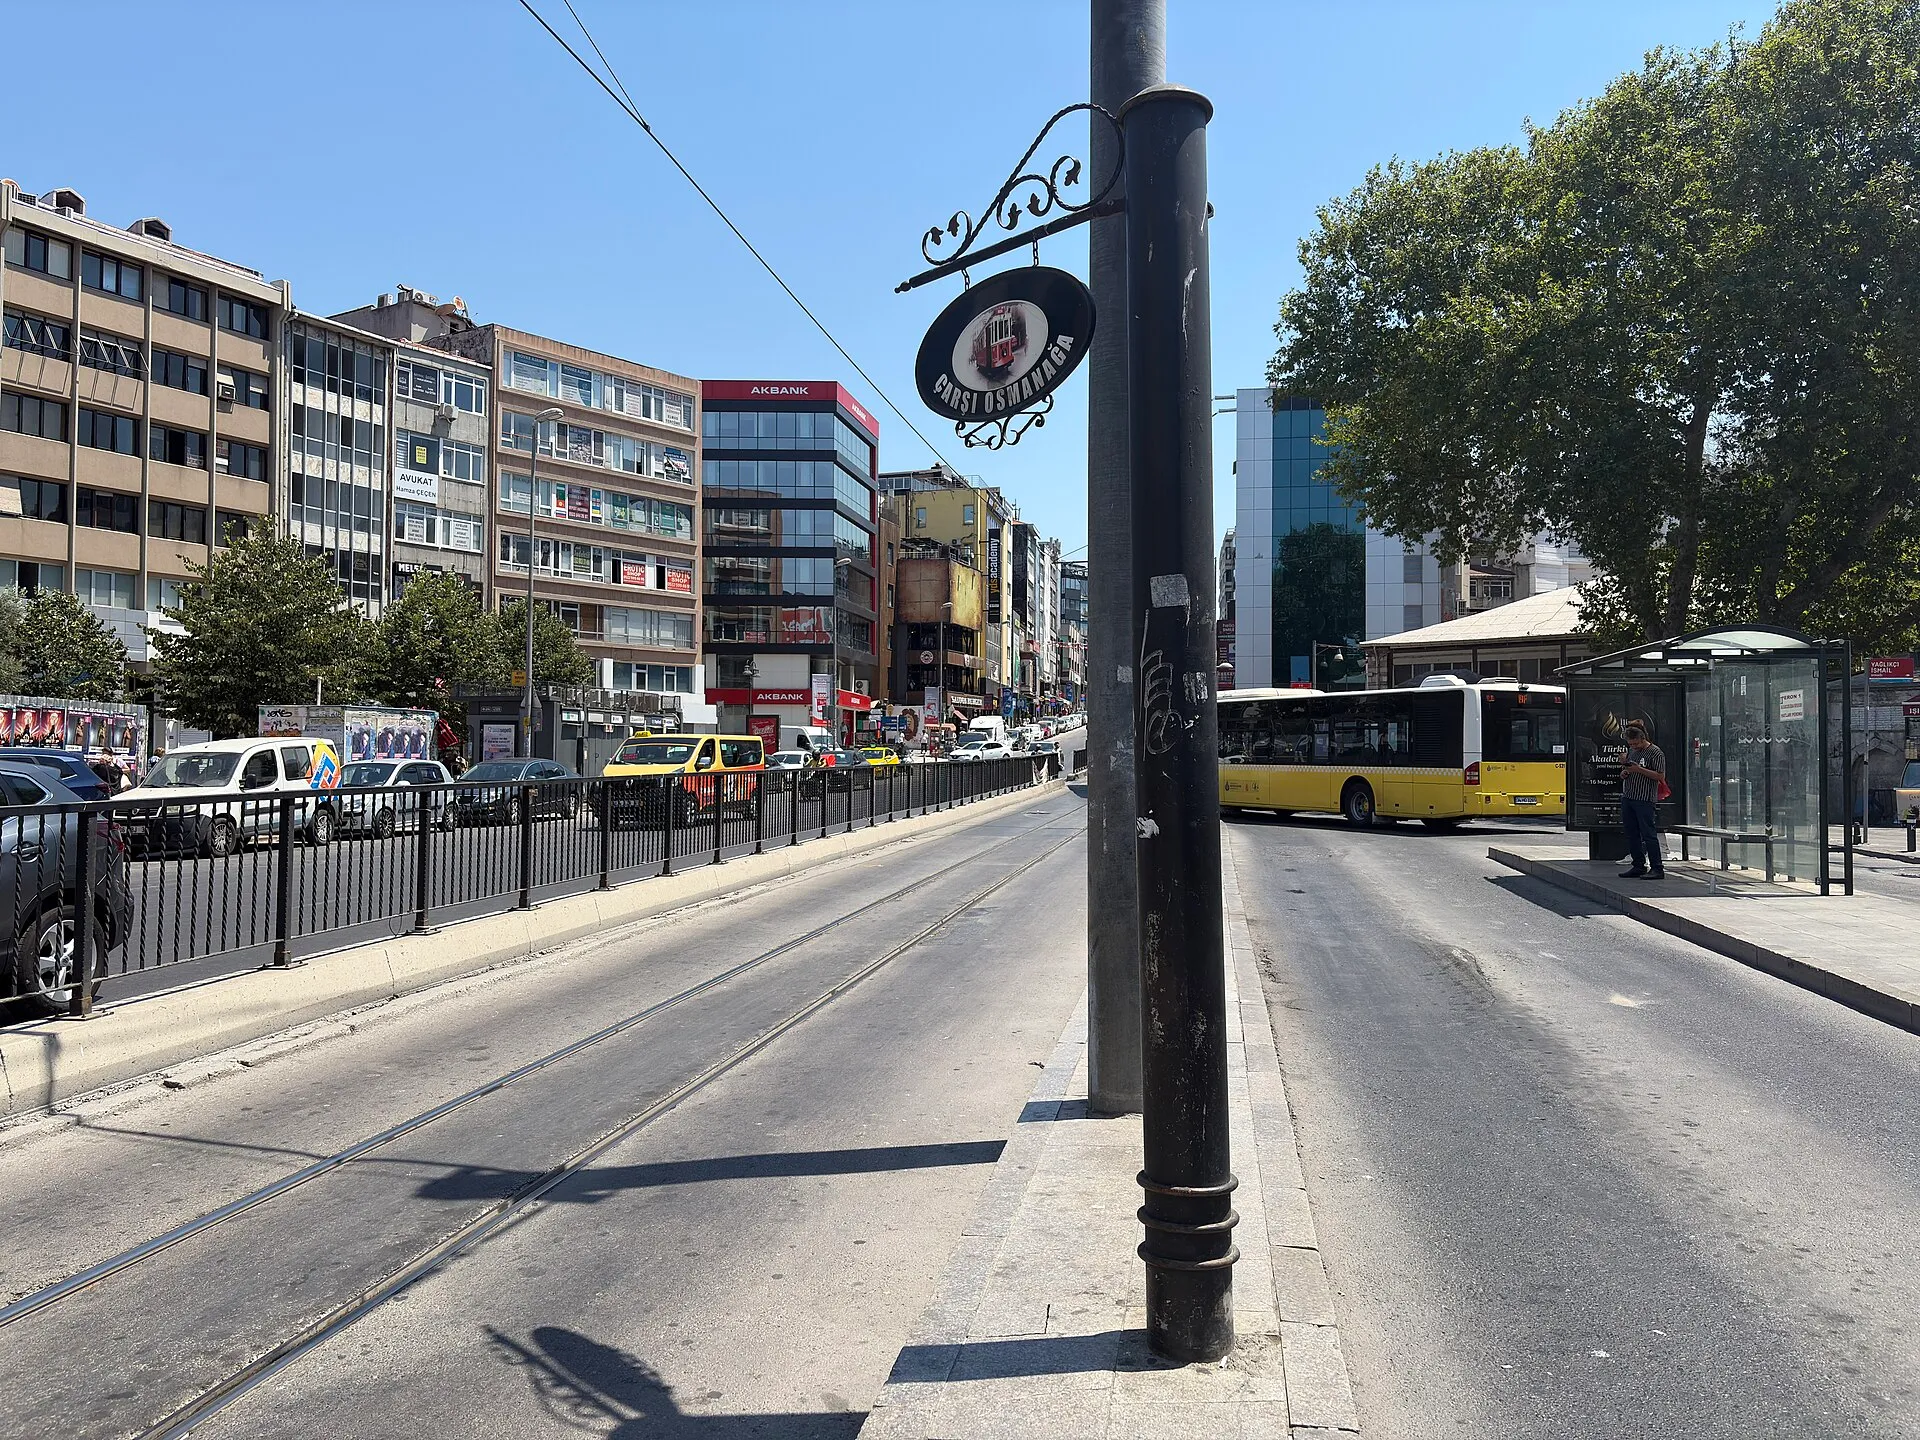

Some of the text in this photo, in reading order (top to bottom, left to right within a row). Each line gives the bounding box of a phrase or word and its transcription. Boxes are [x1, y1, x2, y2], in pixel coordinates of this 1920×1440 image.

[933, 333, 1075, 416] ÇARŞI OSMANAĞA
[751, 386, 809, 395] AKBANK
[400, 473, 433, 486] AVUKAT
[396, 485, 437, 498] Hamza ÇEÇEN
[623, 563, 645, 574] EROTIC
[668, 568, 691, 580] EROTIC
[671, 576, 688, 584] SHOP
[757, 693, 804, 701] AKBANK
